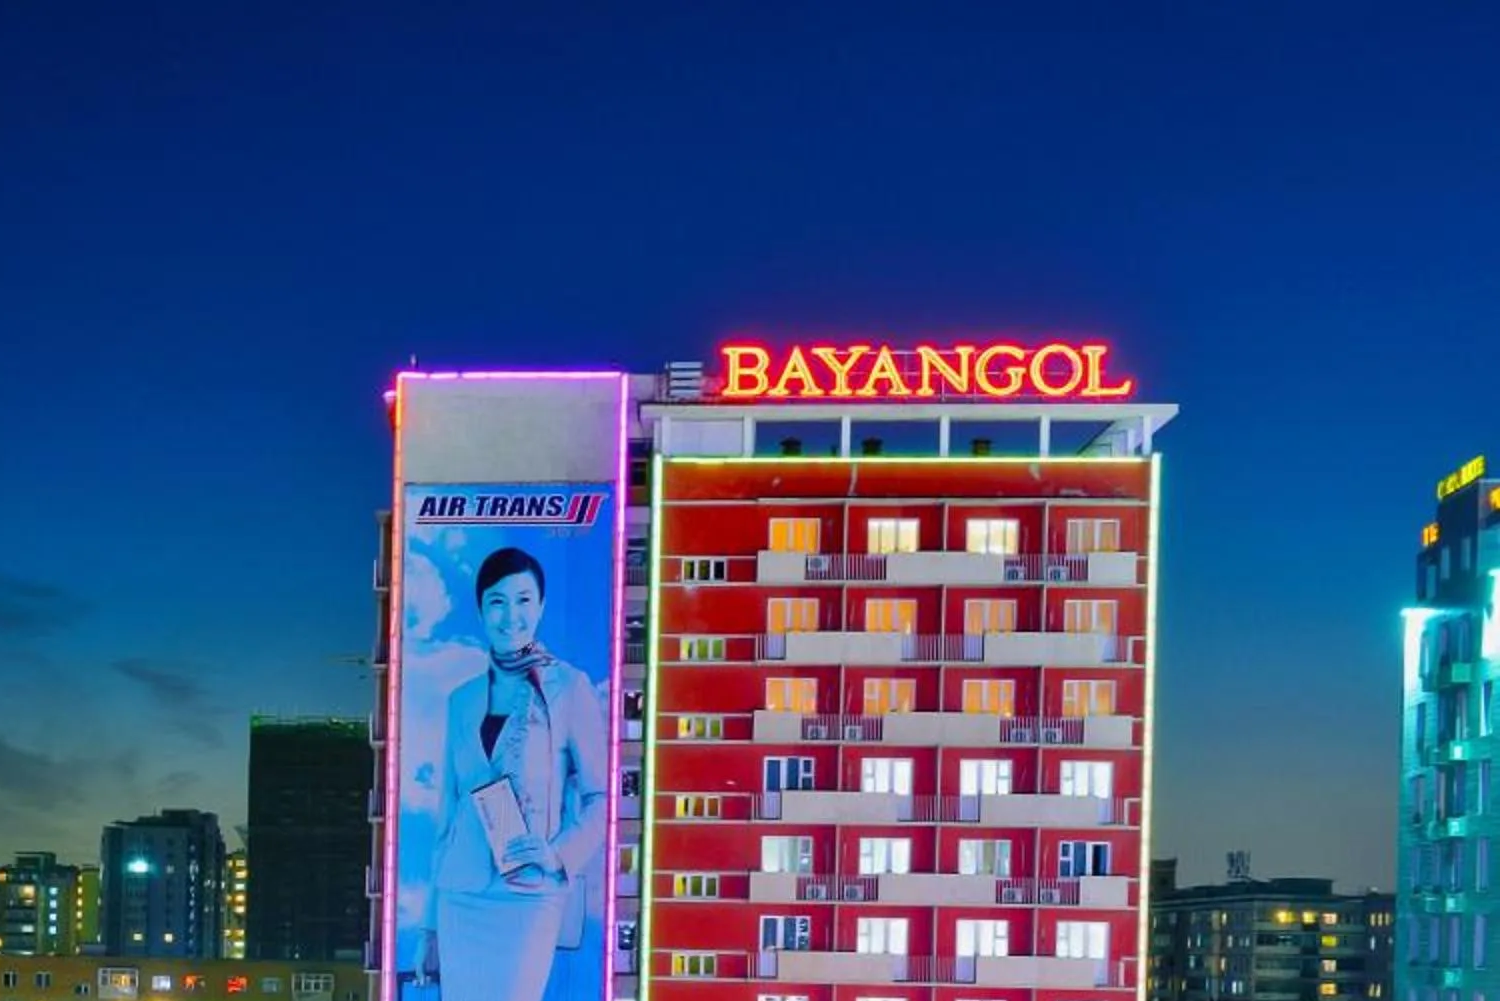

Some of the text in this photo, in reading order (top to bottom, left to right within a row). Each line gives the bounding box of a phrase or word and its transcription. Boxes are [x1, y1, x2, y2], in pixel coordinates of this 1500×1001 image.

[721, 344, 1132, 397] BAYANGOL
[419, 495, 565, 517] AIR TRANS
